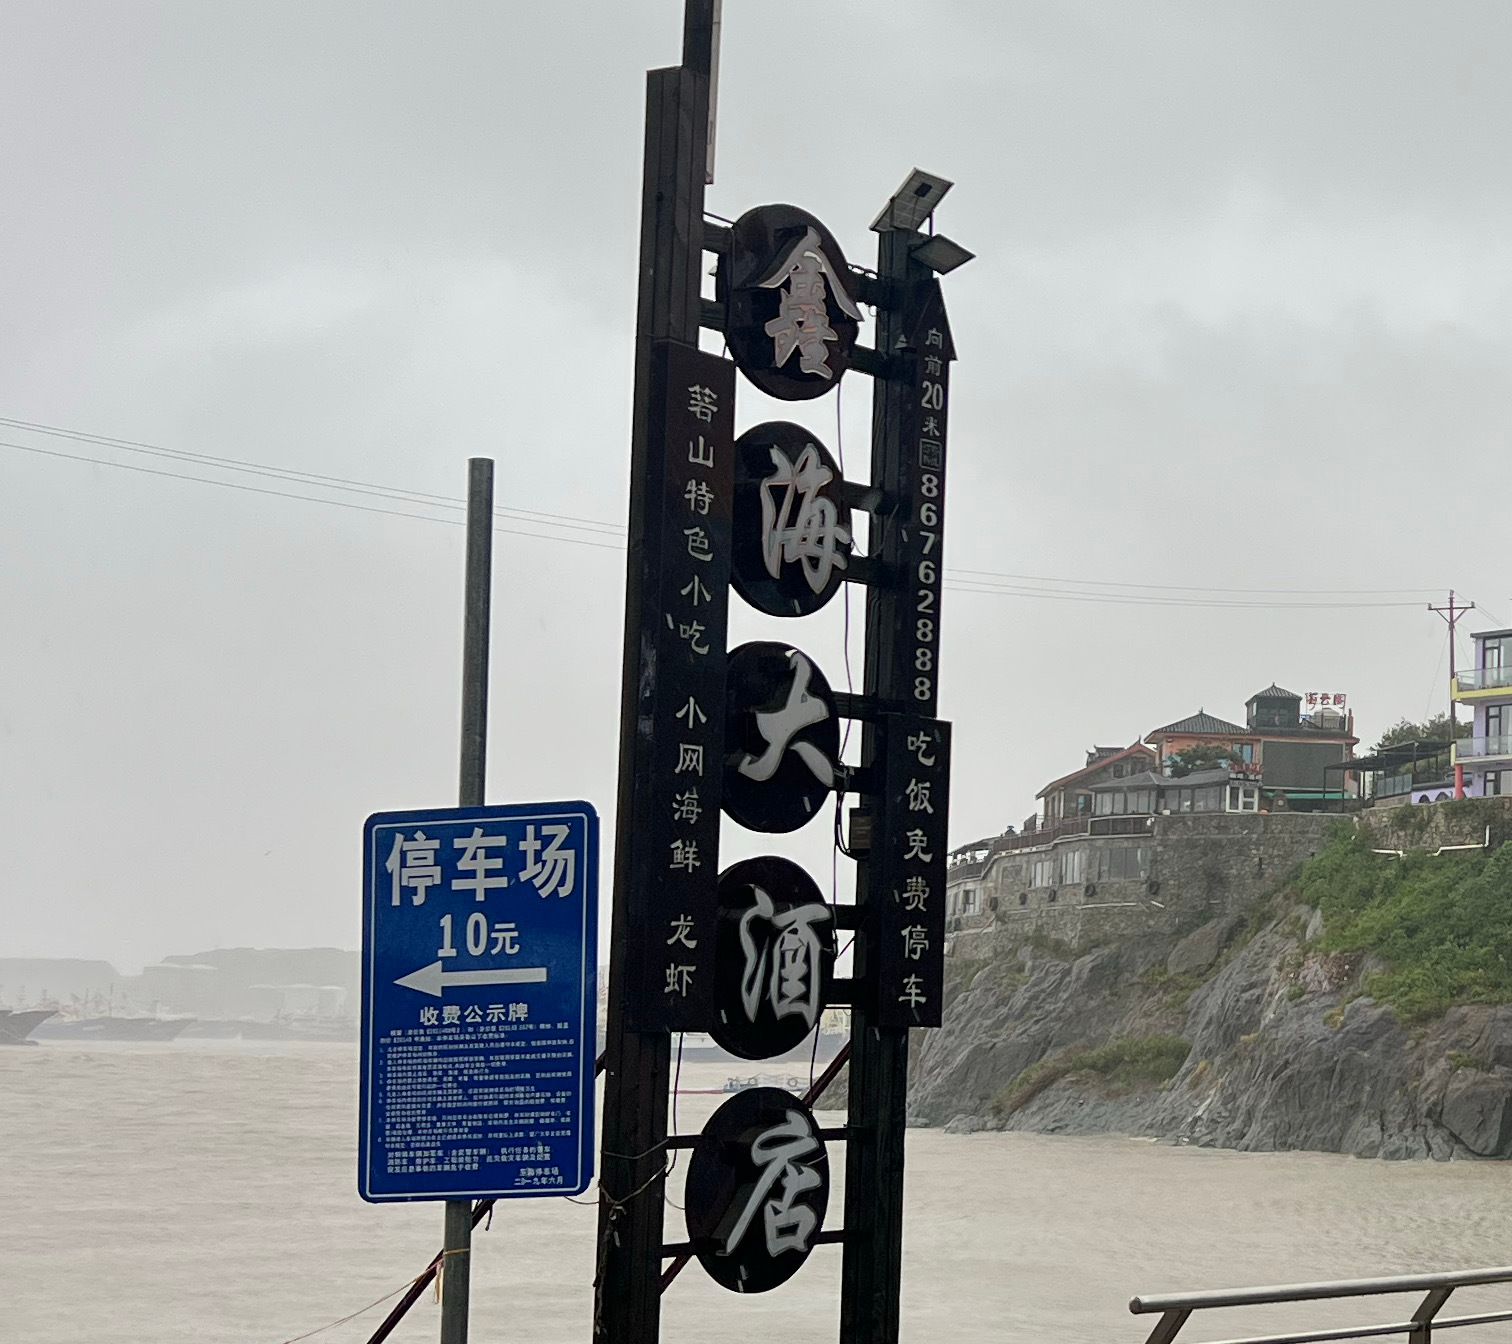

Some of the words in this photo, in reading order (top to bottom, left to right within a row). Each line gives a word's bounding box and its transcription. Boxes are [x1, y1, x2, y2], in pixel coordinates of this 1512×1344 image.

[679, 384, 719, 655] 箬山特色小吃
[912, 473, 939, 702] 86762888
[668, 695, 708, 874] 小网海鲜
[385, 823, 577, 907] 停车场
[898, 731, 936, 1007] 吃饭免费停车
[437, 911, 521, 958] 10元
[664, 914, 699, 998] 龙虾
[419, 1002, 529, 1027] 收费公示牌
